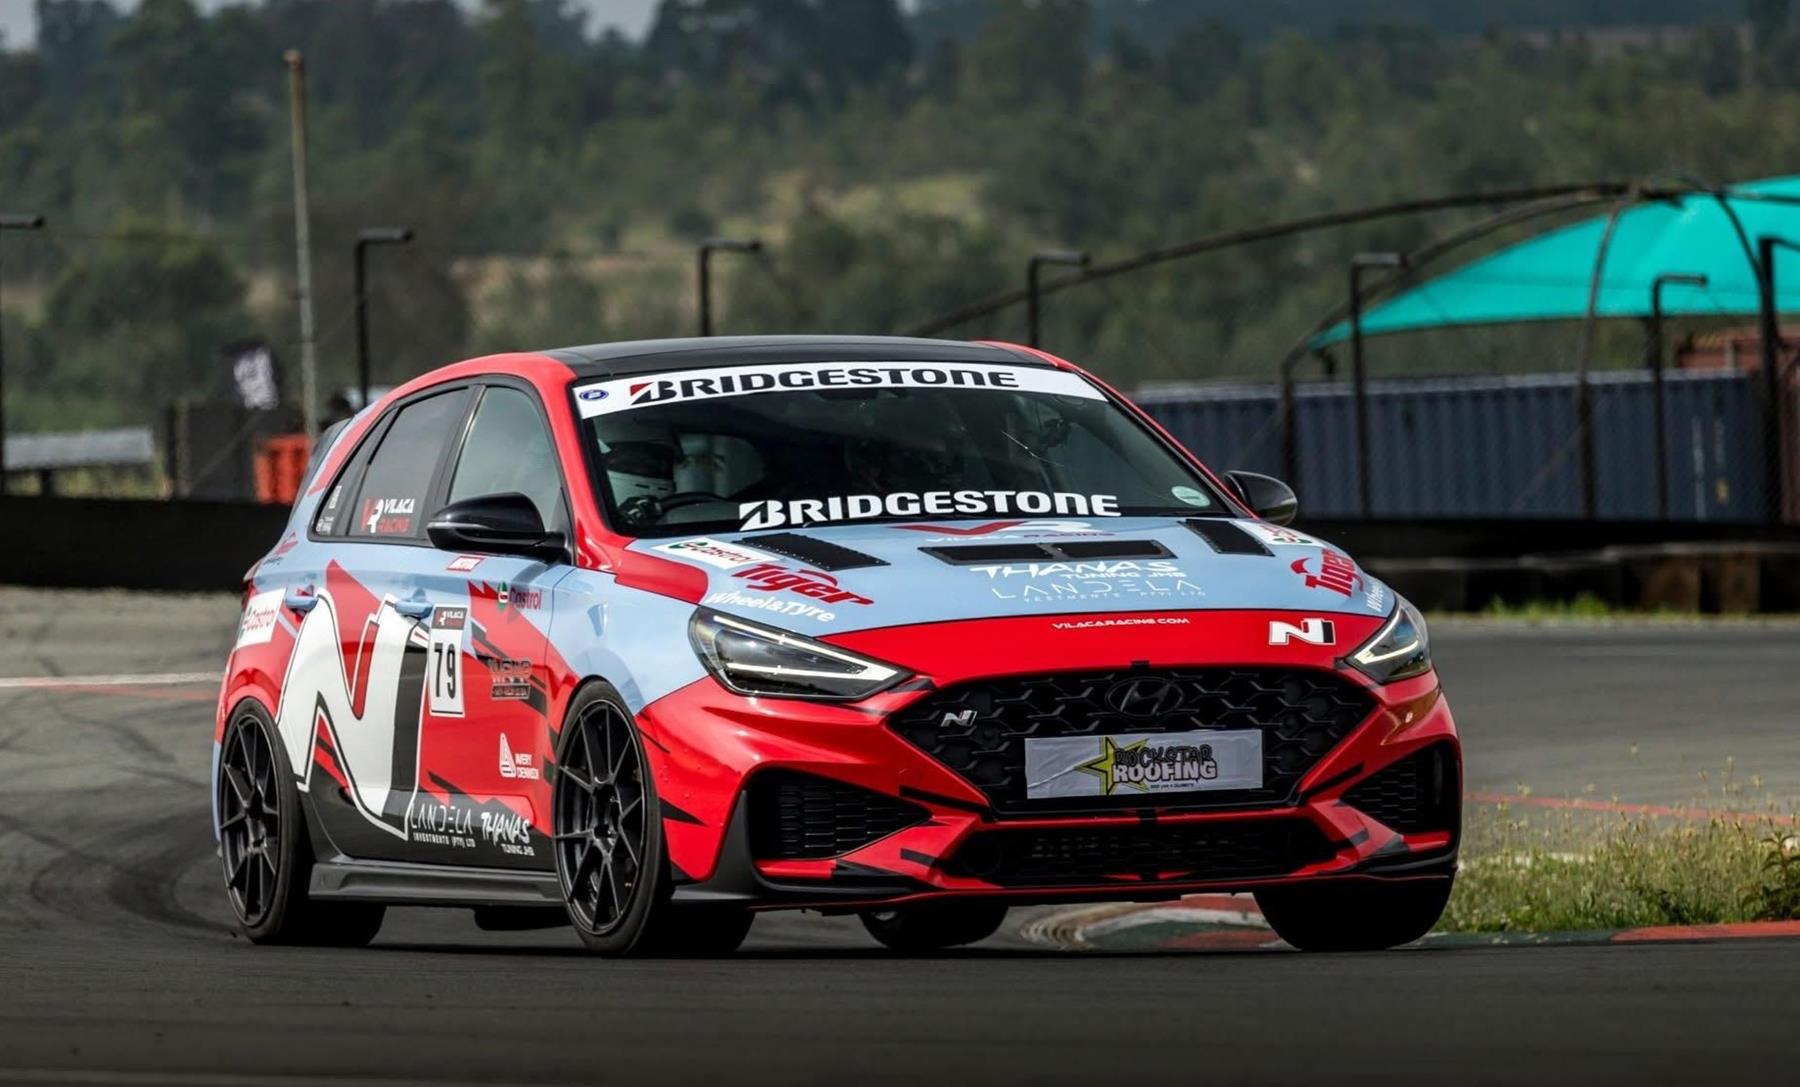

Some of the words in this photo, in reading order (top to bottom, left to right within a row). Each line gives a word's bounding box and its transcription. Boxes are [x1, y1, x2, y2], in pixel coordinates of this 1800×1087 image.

[630, 367, 1019, 405] BRIDGESTONE
[384, 499, 415, 514] VILACA
[739, 491, 1122, 531] BRIDGESTONE
[969, 561, 1179, 580] THANAS
[1061, 571, 1141, 579] TUNING
[731, 563, 875, 606] Tiger
[991, 579, 1201, 599] LANDELA
[509, 588, 542, 610] Castrol
[434, 642, 456, 699] 79
[1114, 744, 1214, 768] ROCKSTAR
[1112, 759, 1218, 784] ROOFING
[410, 802, 473, 835] LANDELA
[481, 811, 530, 846] THANAS
